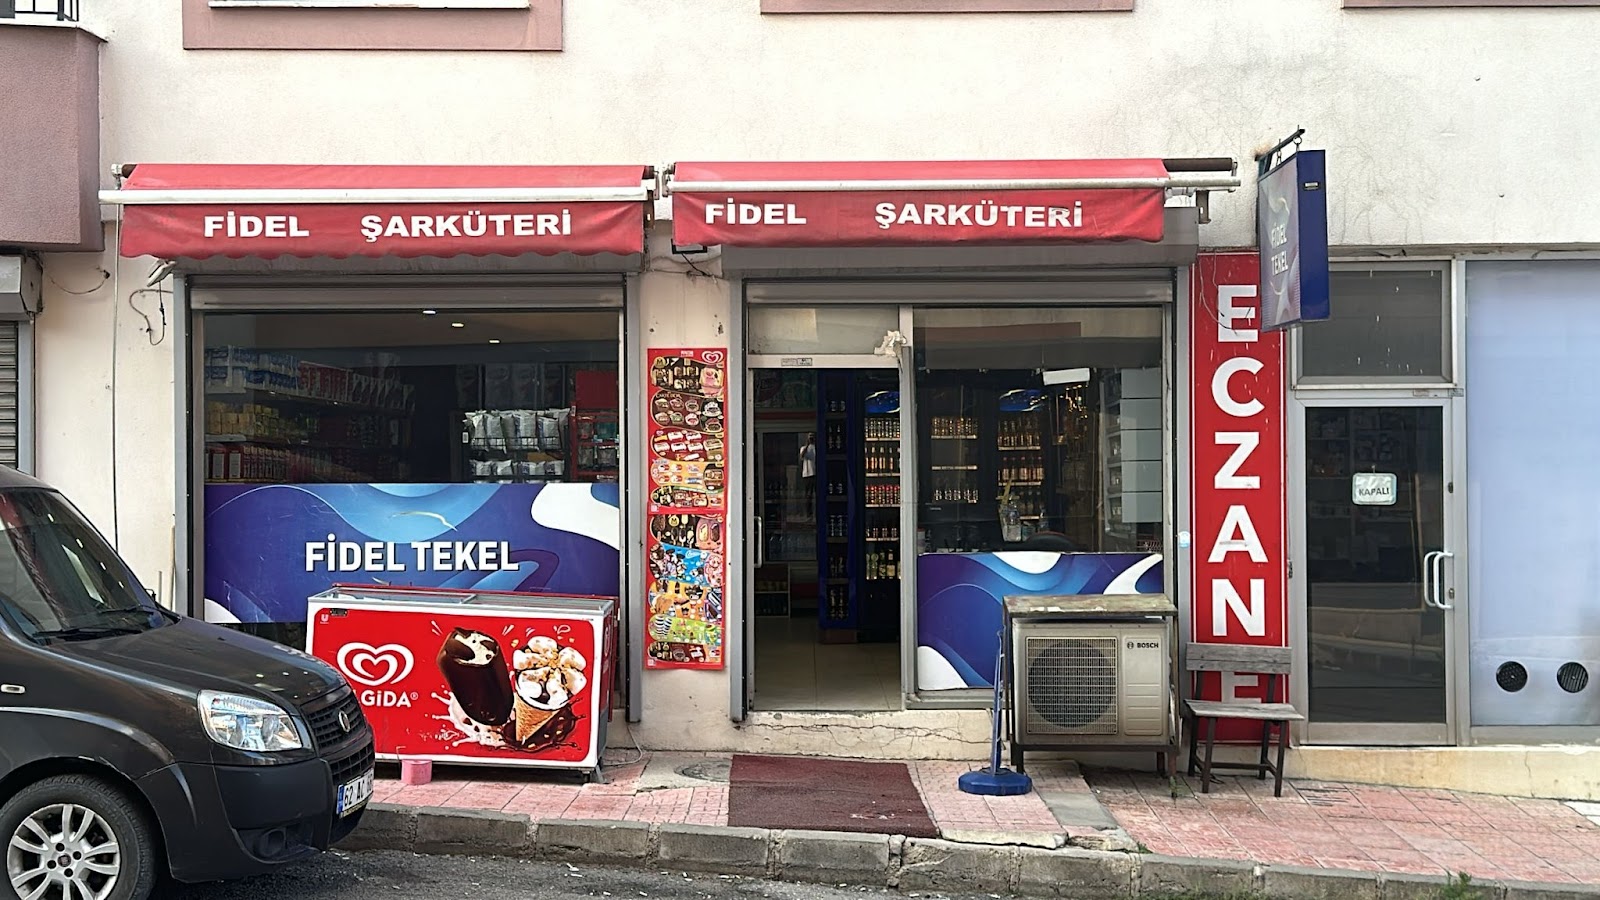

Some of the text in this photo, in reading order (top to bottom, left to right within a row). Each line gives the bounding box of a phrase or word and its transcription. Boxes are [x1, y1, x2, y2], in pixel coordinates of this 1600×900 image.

[204, 208, 571, 243] FİDEL ŞARKÜTERİ
[705, 197, 1083, 230] FİDEL ŞARKÜTERİ
[1271, 250, 1289, 276] TEKEL
[1358, 487, 1390, 496] KAPALI
[305, 533, 519, 572] FİDEL TEKEL
[344, 785, 354, 807] 62
